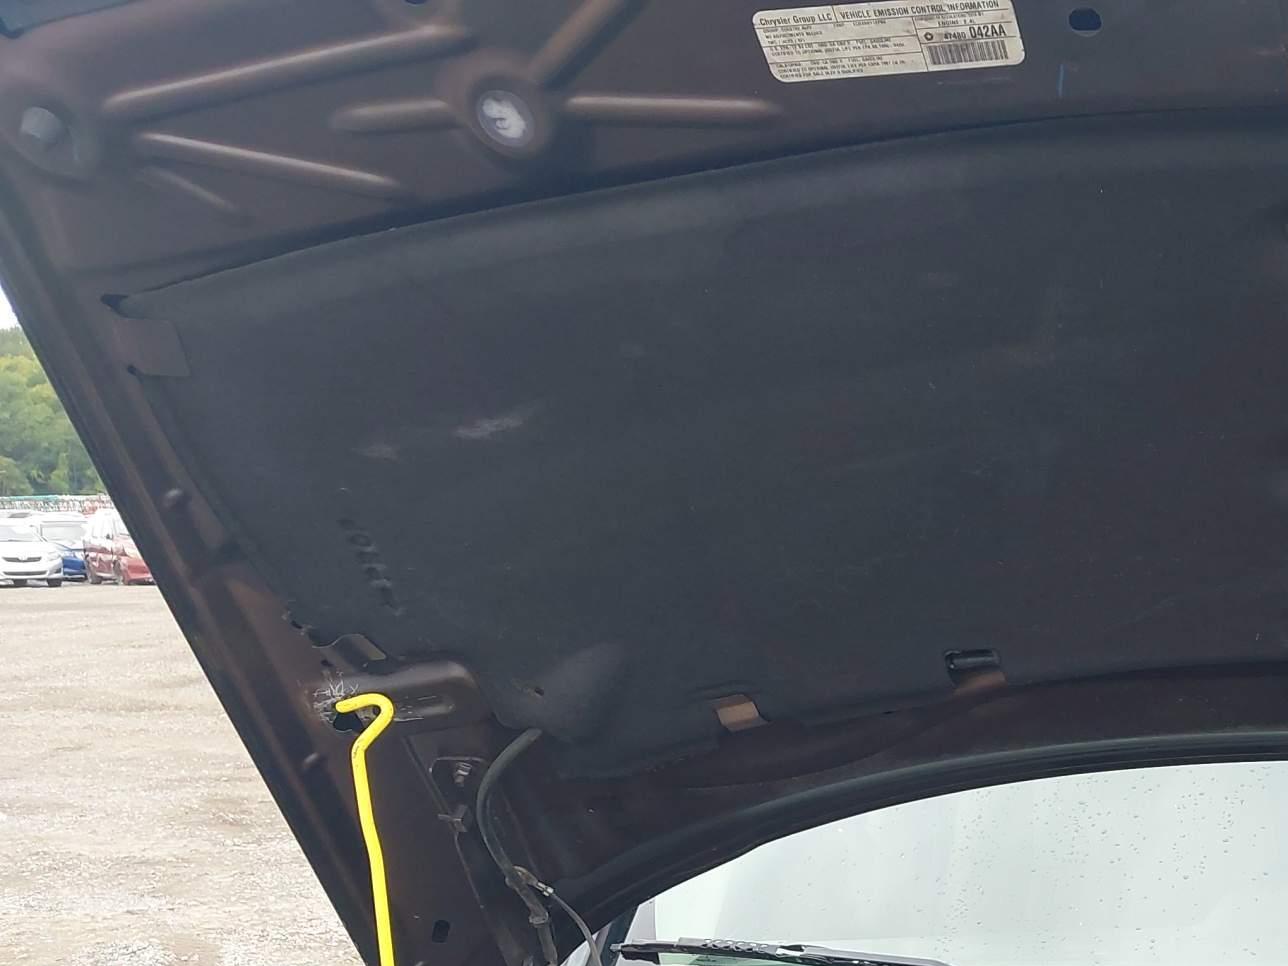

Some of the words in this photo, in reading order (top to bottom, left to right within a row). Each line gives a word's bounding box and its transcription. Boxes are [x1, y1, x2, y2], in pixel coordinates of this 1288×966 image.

[840, 9, 870, 20] VEHICLE
[873, 6, 909, 17] EMISSION
[911, 4, 946, 15] CONTROL
[948, 0, 1000, 12] INFORMATION
[760, 16, 791, 26] Chrysler
[793, 15, 816, 24] Group
[818, 13, 833, 22] LLC
[968, 24, 1007, 38] 042AA
